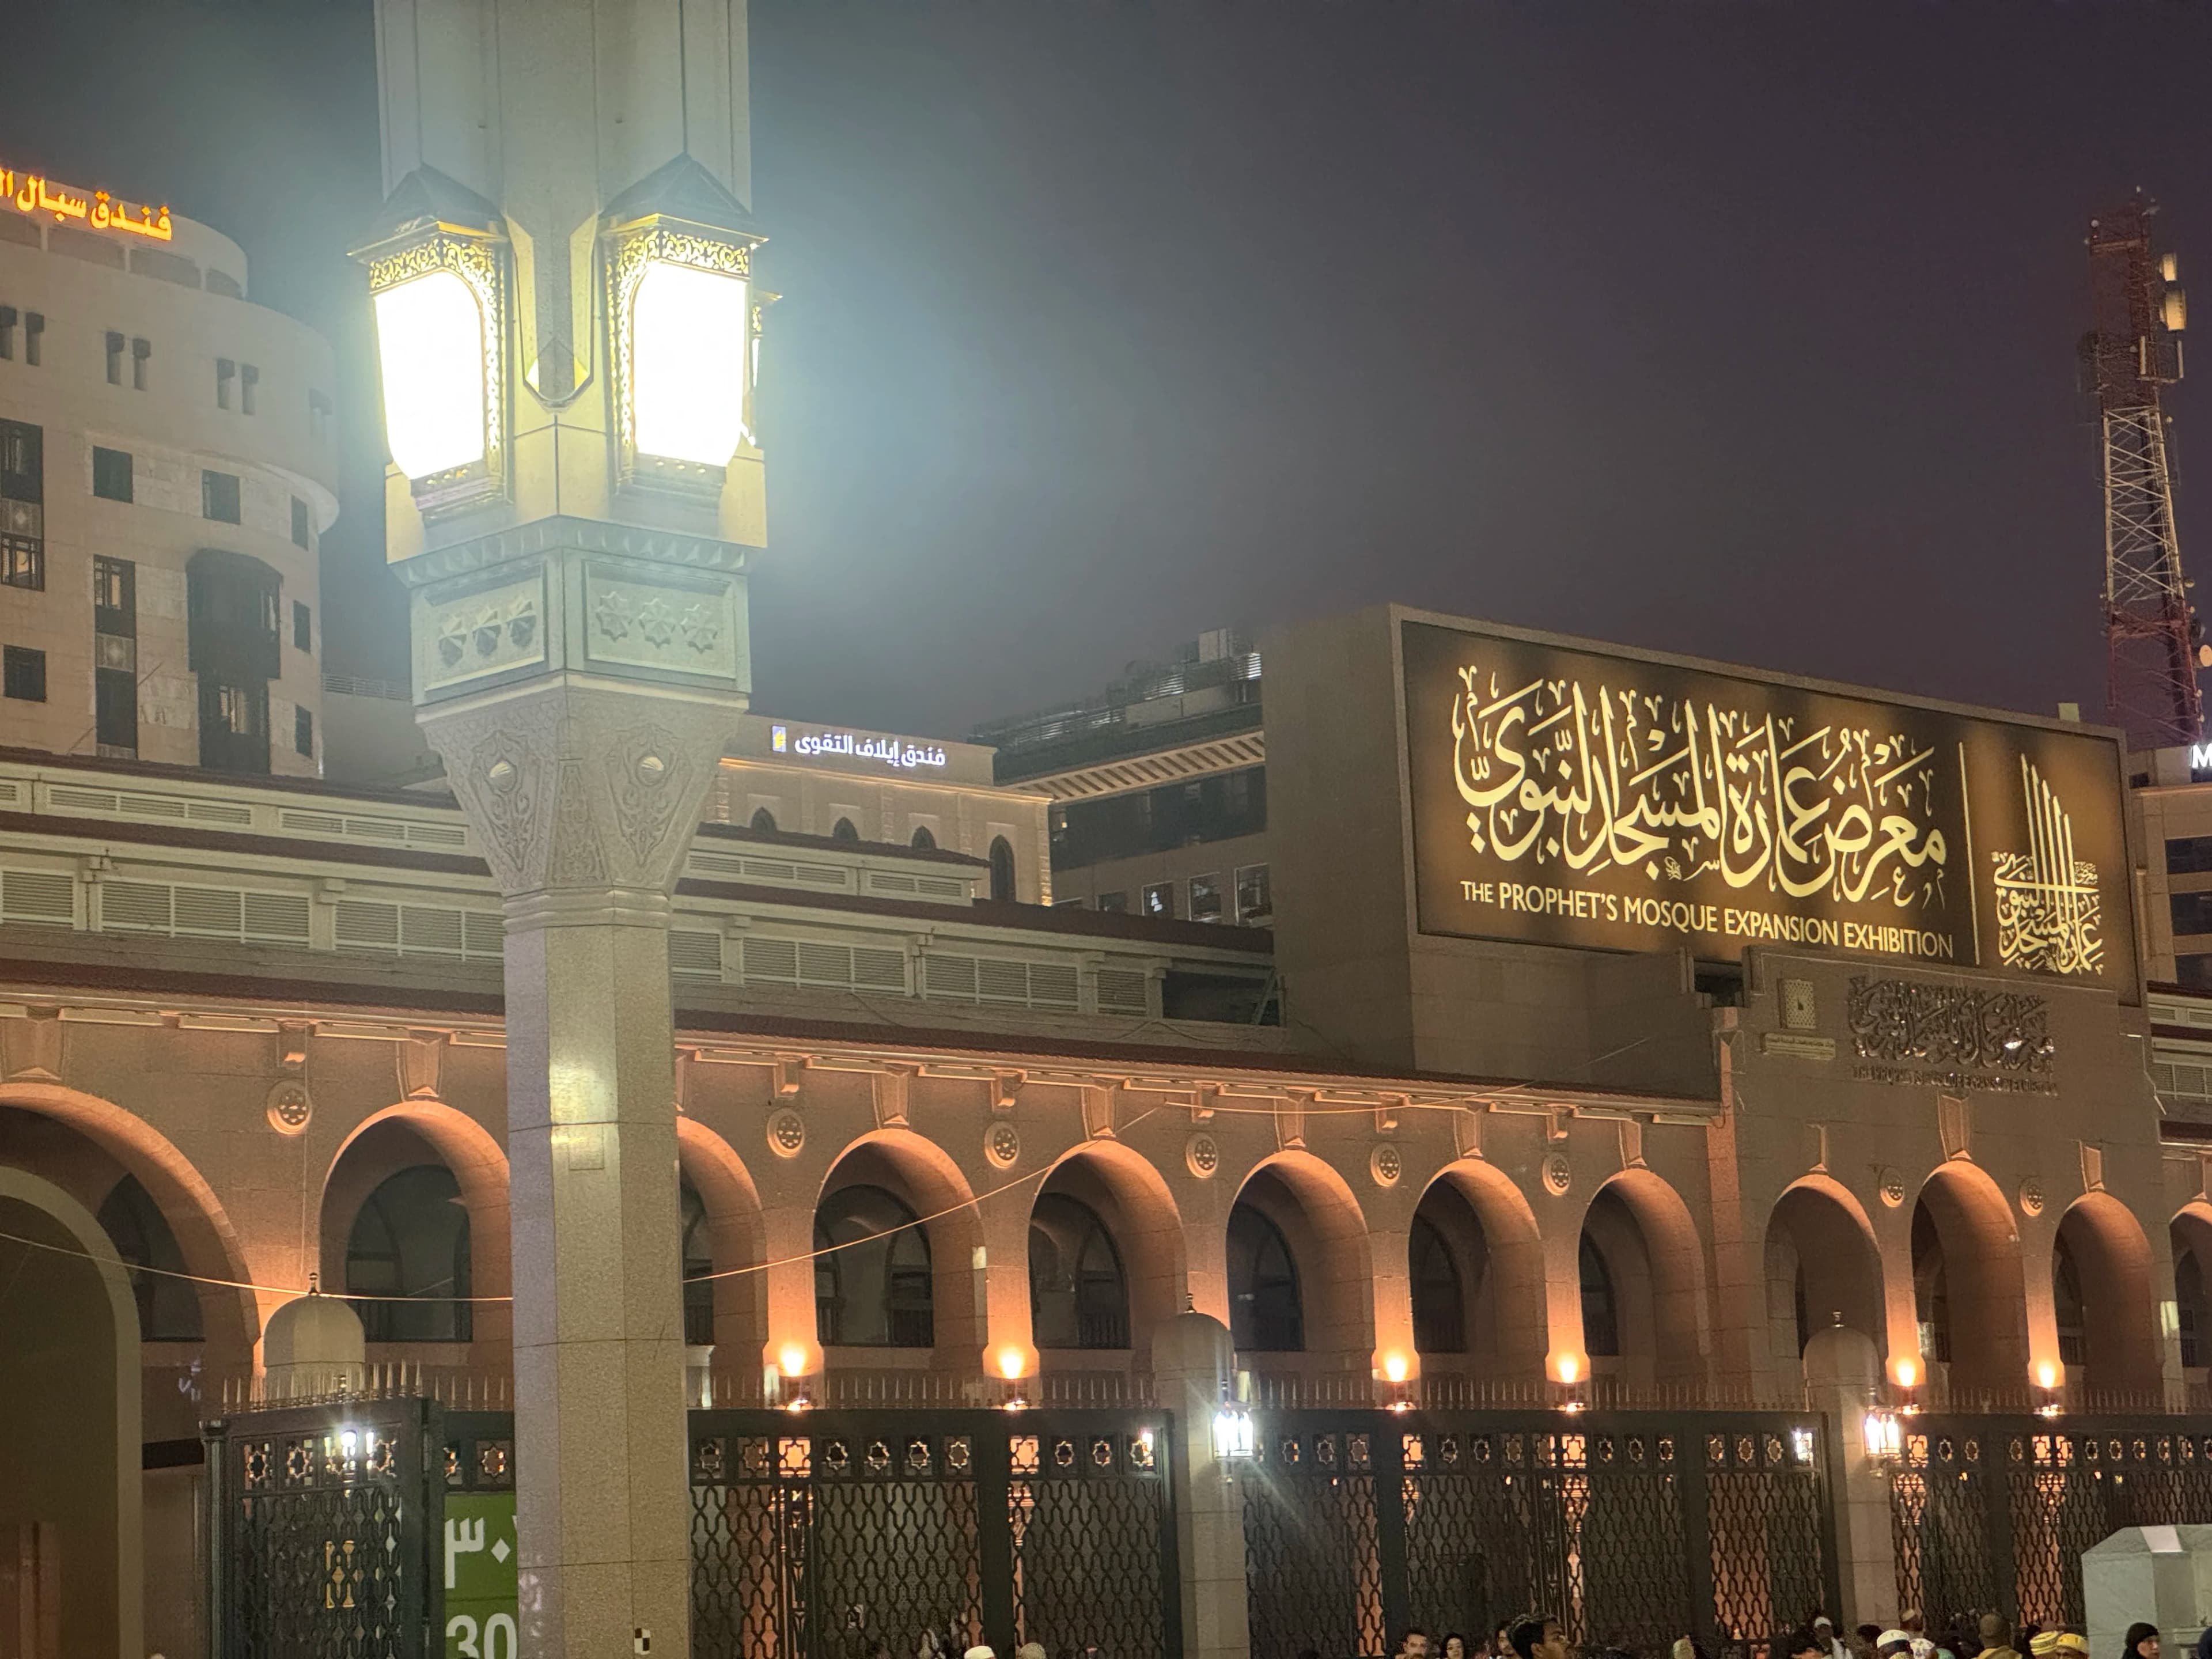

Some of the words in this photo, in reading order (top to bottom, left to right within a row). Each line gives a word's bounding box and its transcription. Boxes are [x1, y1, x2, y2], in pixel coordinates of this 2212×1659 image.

[90, 191, 172, 241] فندق
[794, 733, 854, 755] التقوى
[855, 738, 900, 767] إيلاف
[901, 745, 946, 767] فندق
[1460, 881, 1494, 903] THE
[1499, 882, 1617, 922] PROPHET'S
[1624, 896, 1718, 933] MOSQUE
[1724, 908, 1839, 946] EXPANSION
[1843, 922, 1953, 958] EXHIBITION
